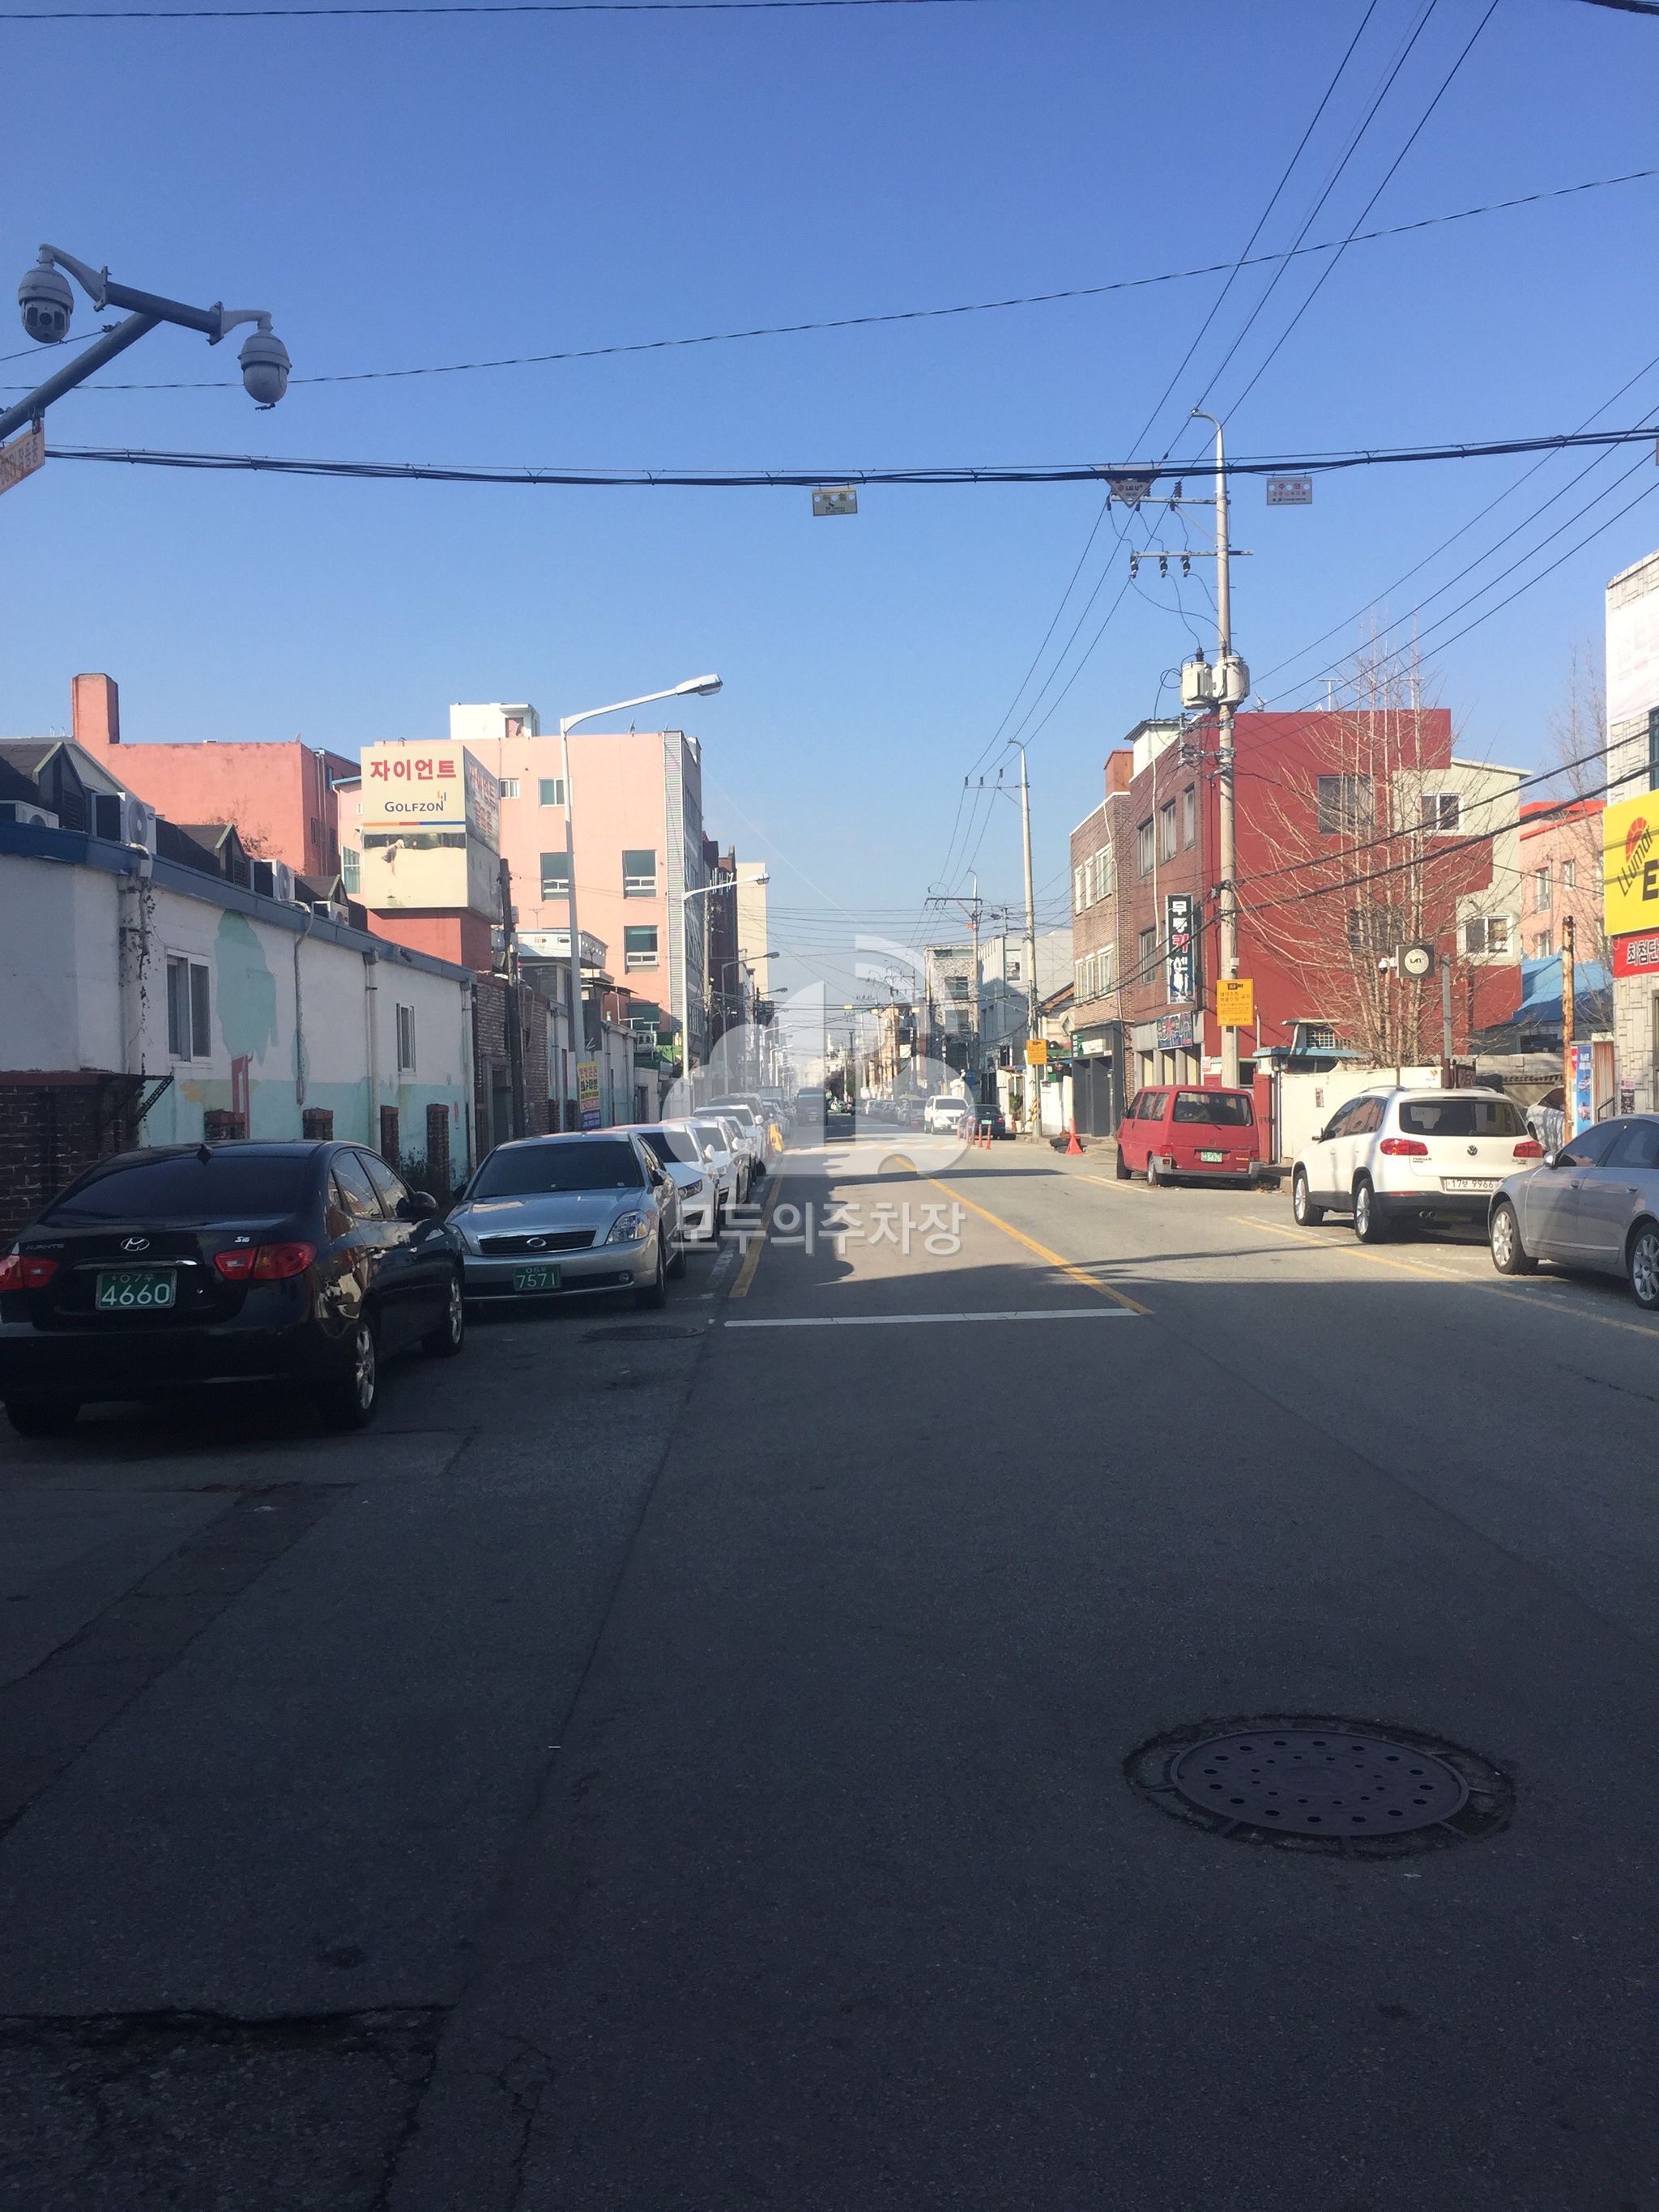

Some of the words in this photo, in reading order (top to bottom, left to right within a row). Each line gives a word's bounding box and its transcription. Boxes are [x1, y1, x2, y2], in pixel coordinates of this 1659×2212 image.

[370, 759, 457, 782] 자이언트
[384, 800, 445, 812] GOLFZON
[1472, 1179, 1494, 1189] 9966
[516, 1272, 556, 1289] 7571
[100, 1283, 170, 1306] 4660
